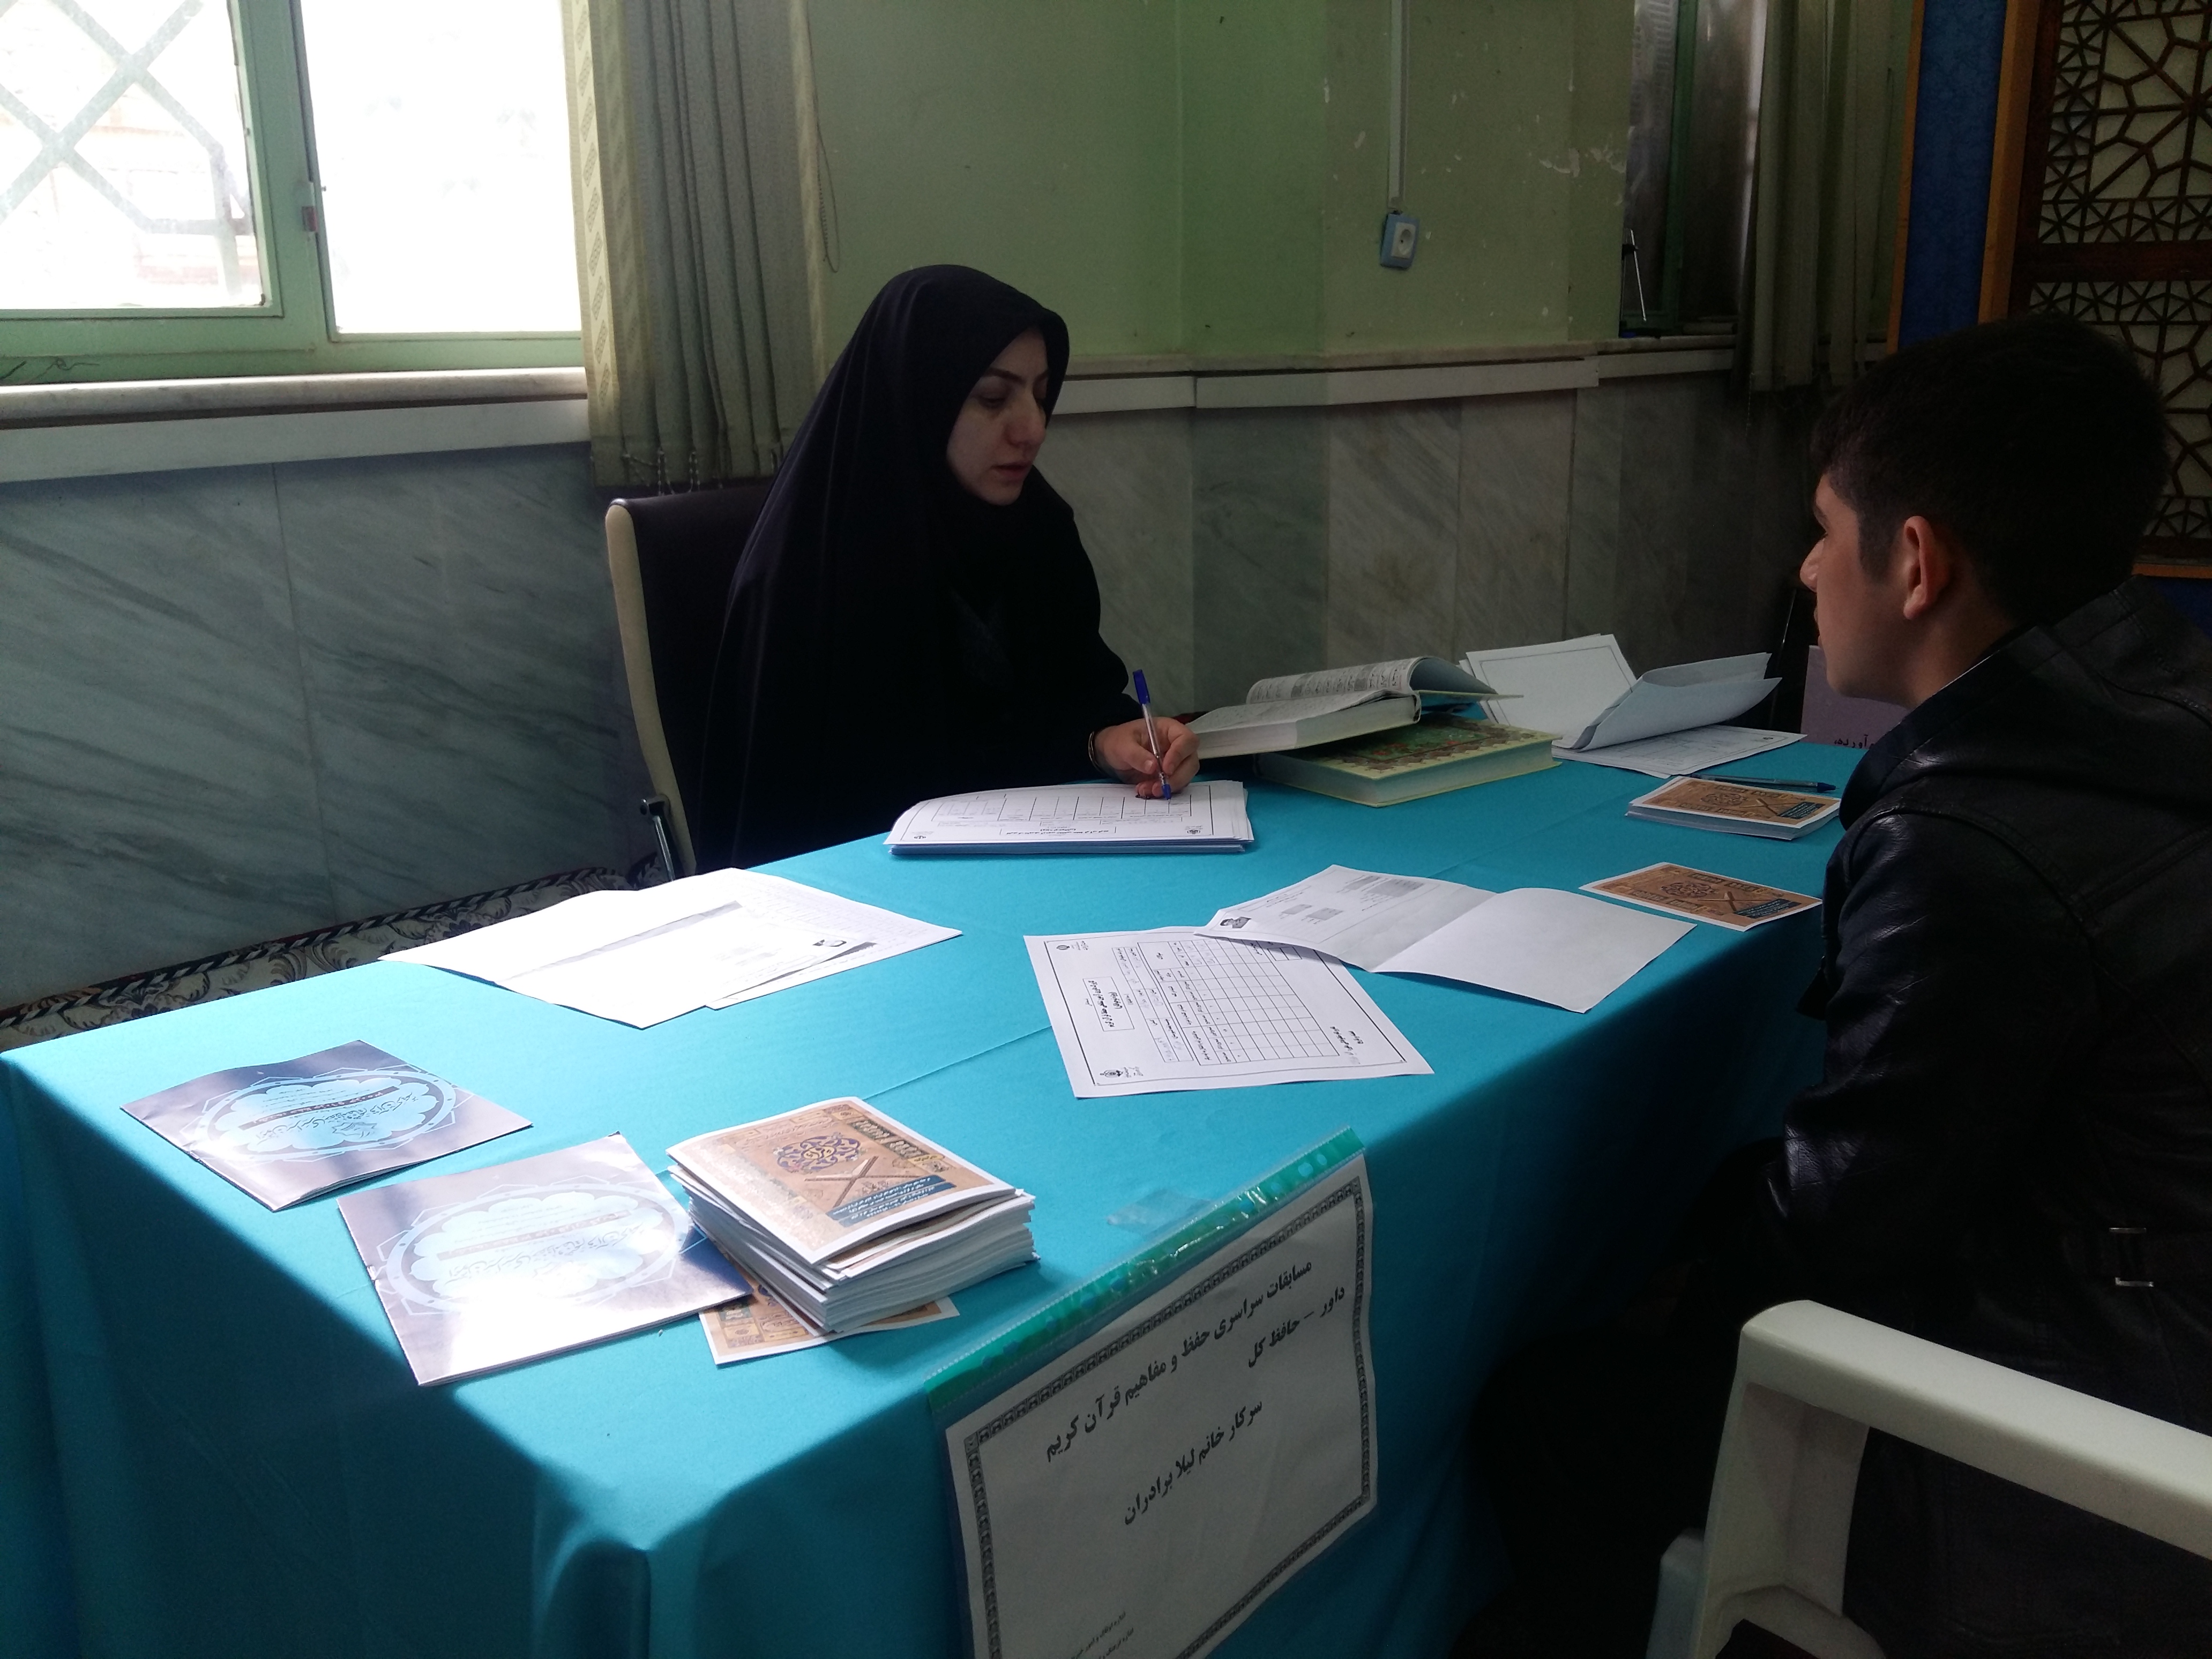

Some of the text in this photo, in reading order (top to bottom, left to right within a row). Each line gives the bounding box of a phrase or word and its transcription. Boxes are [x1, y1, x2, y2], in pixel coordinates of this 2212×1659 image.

[1319, 1286, 1345, 1318] داور
[1269, 1319, 1301, 1347] حافظ
[1047, 1261, 1312, 1463] مسابقات سراسری حفظ و مفاهیم قرآن کریم
[1248, 1337, 1266, 1368] کل
[1124, 1401, 1262, 1526] سرکار خانم لیلا برادران
